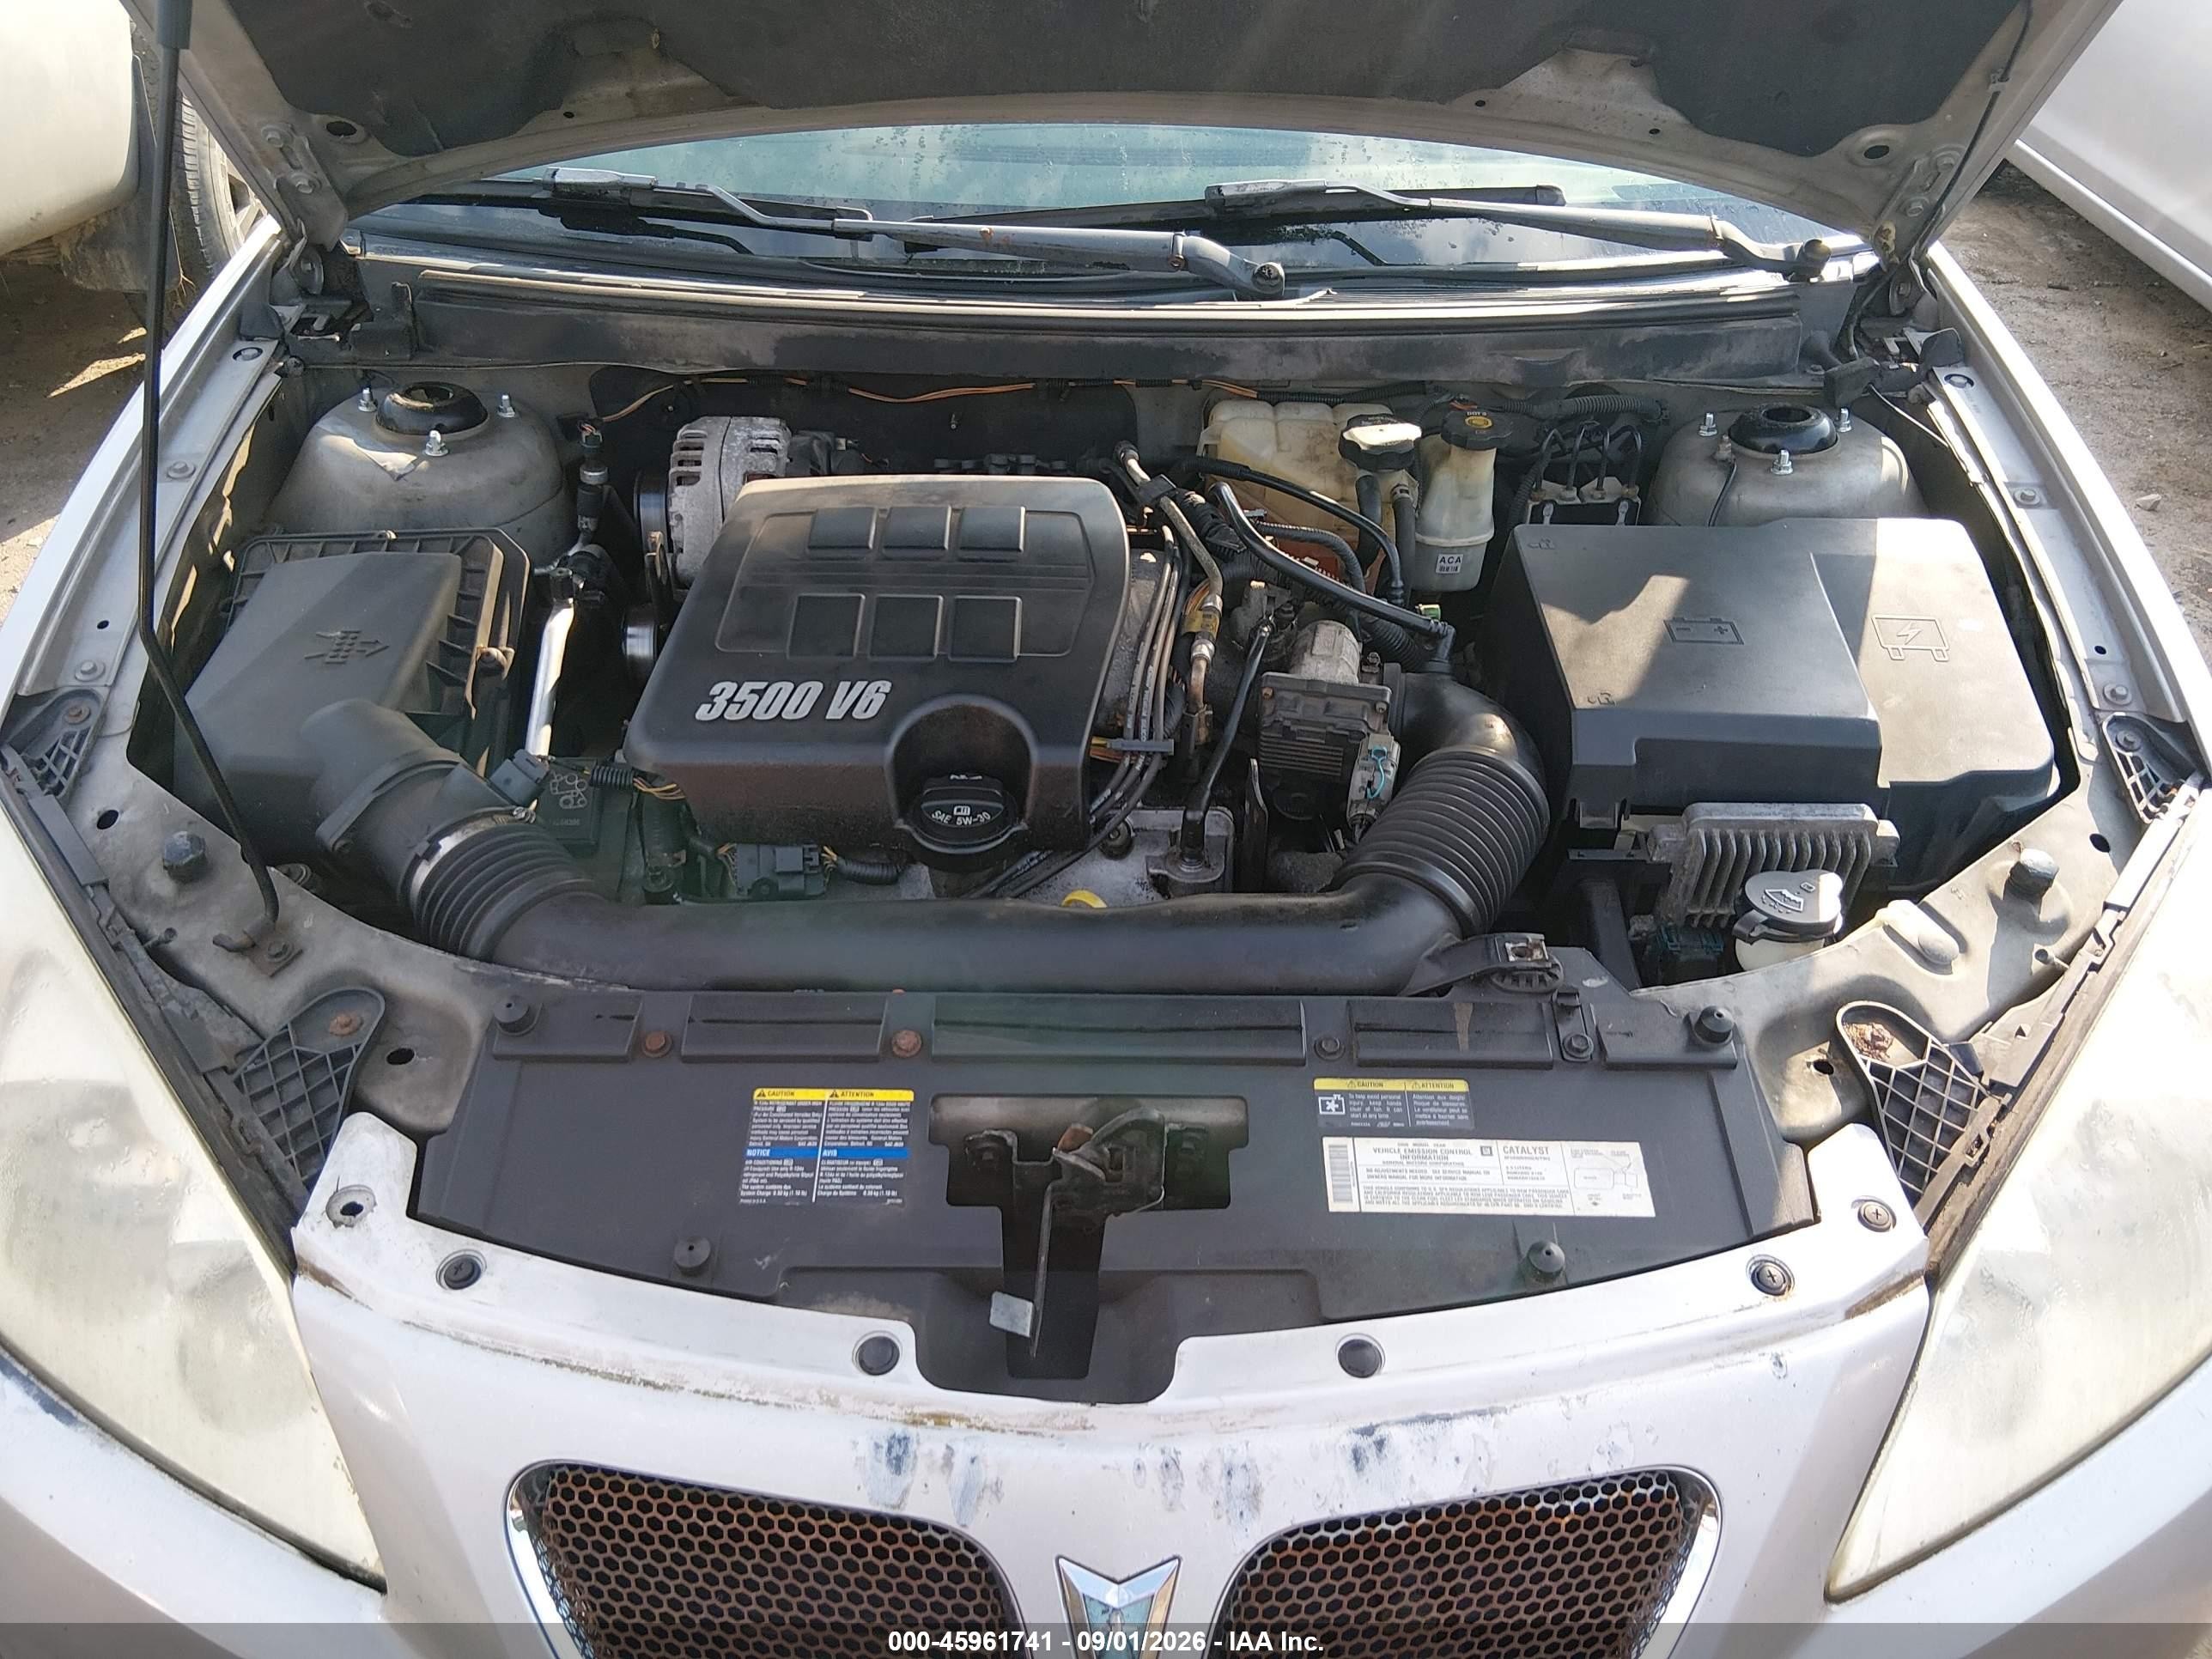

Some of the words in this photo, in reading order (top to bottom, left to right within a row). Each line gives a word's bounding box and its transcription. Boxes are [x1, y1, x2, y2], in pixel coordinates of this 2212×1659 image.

[1439, 556, 1462, 564] ACA
[695, 681, 823, 720] 3500
[825, 680, 892, 720] V6
[932, 810, 951, 824] SAE
[956, 811, 991, 825] 5W-30
[1503, 1146, 1549, 1155] CATALYST
